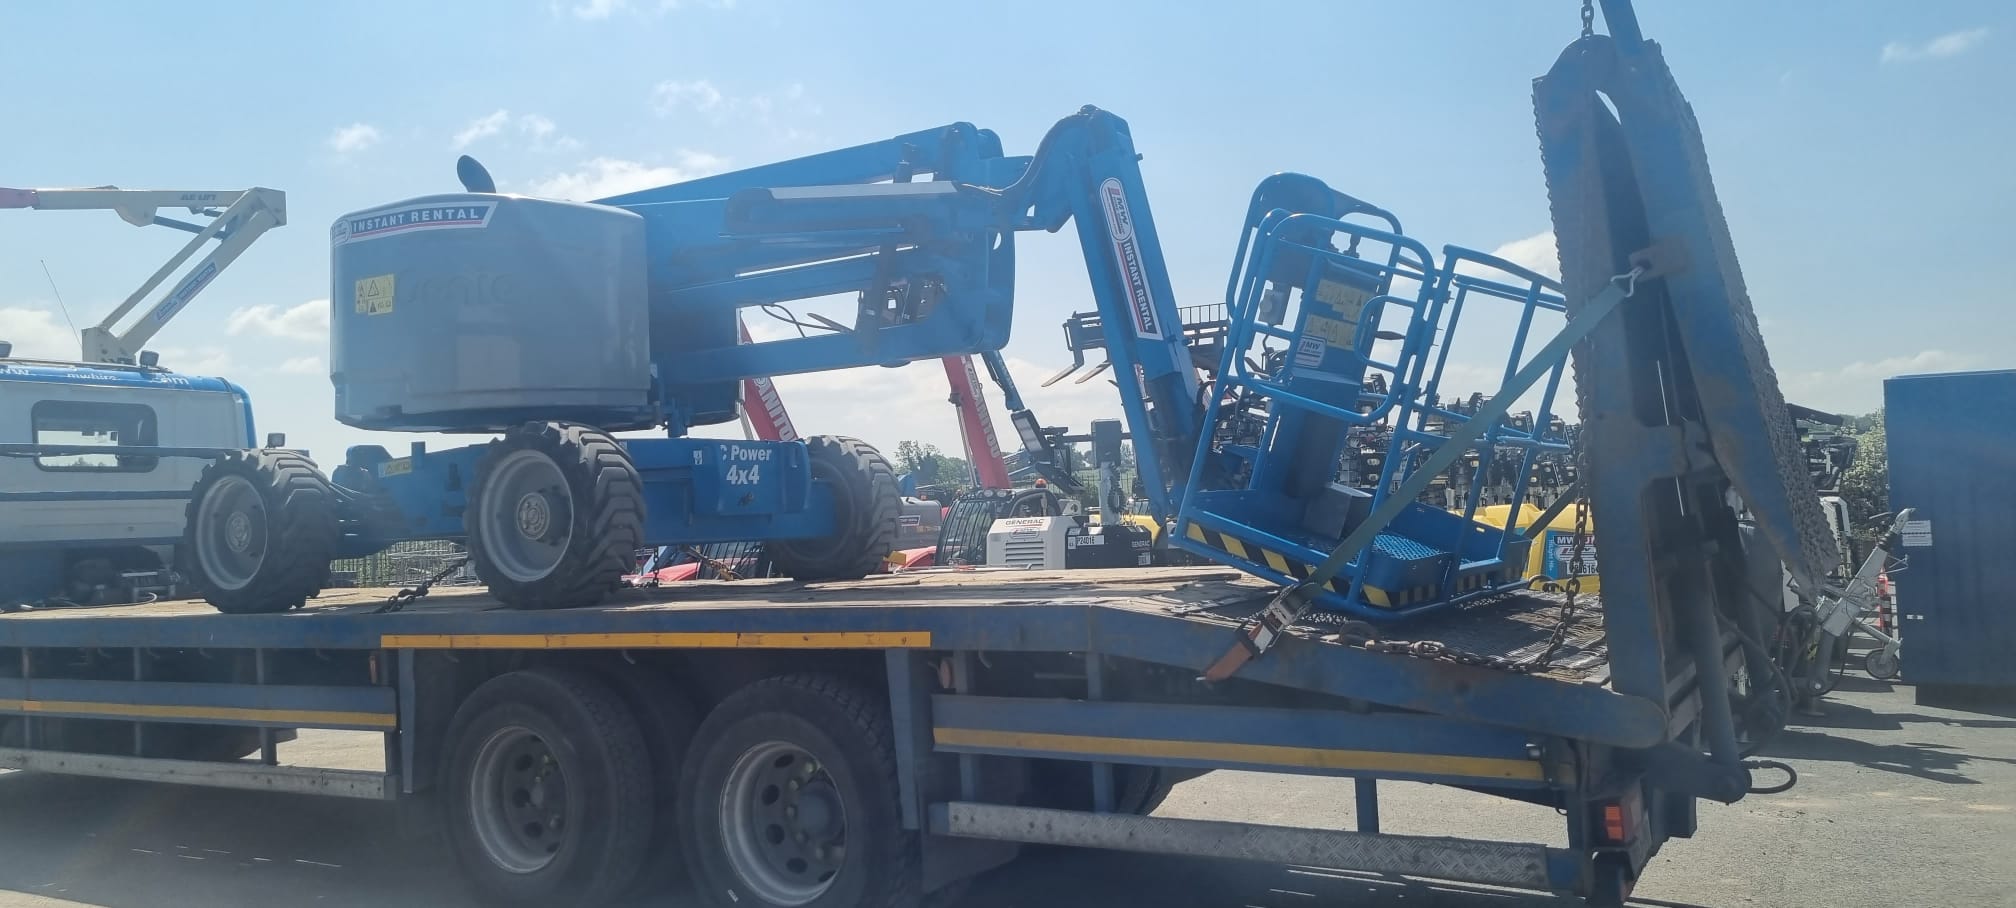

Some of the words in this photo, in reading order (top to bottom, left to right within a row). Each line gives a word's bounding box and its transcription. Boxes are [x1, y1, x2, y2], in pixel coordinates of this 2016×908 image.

[353, 213, 404, 233] INSTANT
[411, 207, 479, 223] RENTAL
[1123, 241, 1142, 290] INSTANT
[1136, 288, 1154, 332] RENTAL
[757, 381, 798, 442] ANITO
[730, 444, 772, 461] Power
[726, 464, 760, 485] 4x4
[1005, 518, 1045, 526] GENERAC
